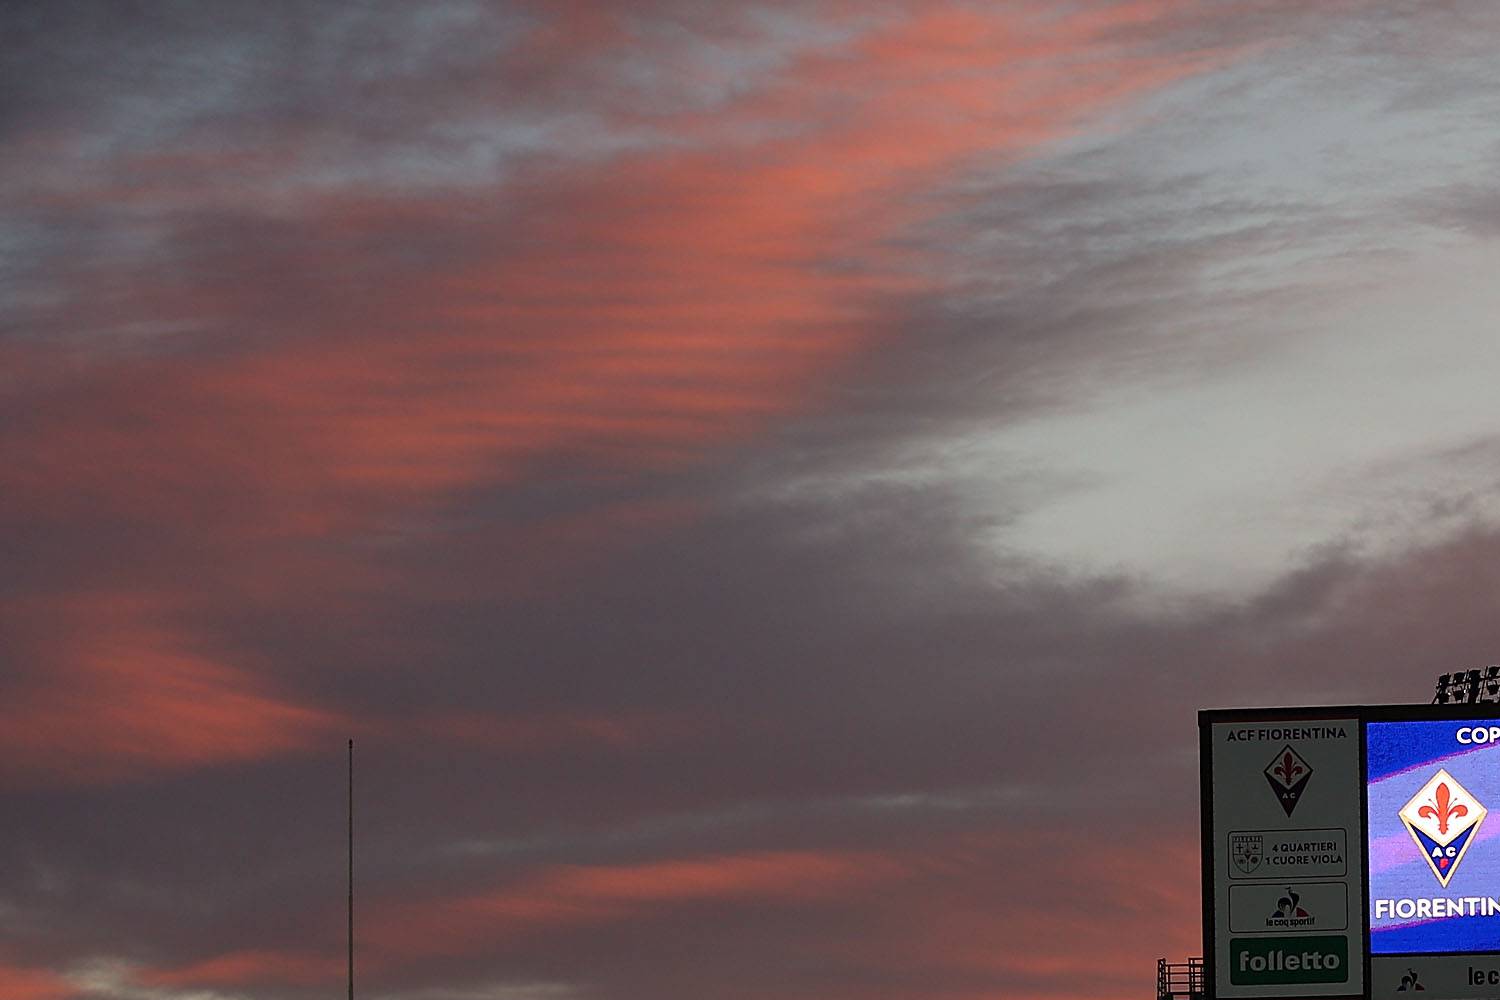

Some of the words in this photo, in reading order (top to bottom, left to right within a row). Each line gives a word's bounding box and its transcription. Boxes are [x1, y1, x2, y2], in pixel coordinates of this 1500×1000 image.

[1227, 729, 1255, 742] ACF
[1258, 727, 1347, 741] FIORENTINA
[1272, 844, 1279, 853] 4
[1280, 842, 1337, 853] QUARTIERI
[1265, 857, 1270, 865] 1
[1273, 855, 1309, 865] CUORE
[1311, 854, 1343, 864] VIOLA
[1266, 918, 1274, 927] le
[1274, 918, 1289, 928] coq
[1289, 917, 1315, 928] sportif
[1239, 950, 1341, 972] folletto
[1468, 966, 1484, 985] le
